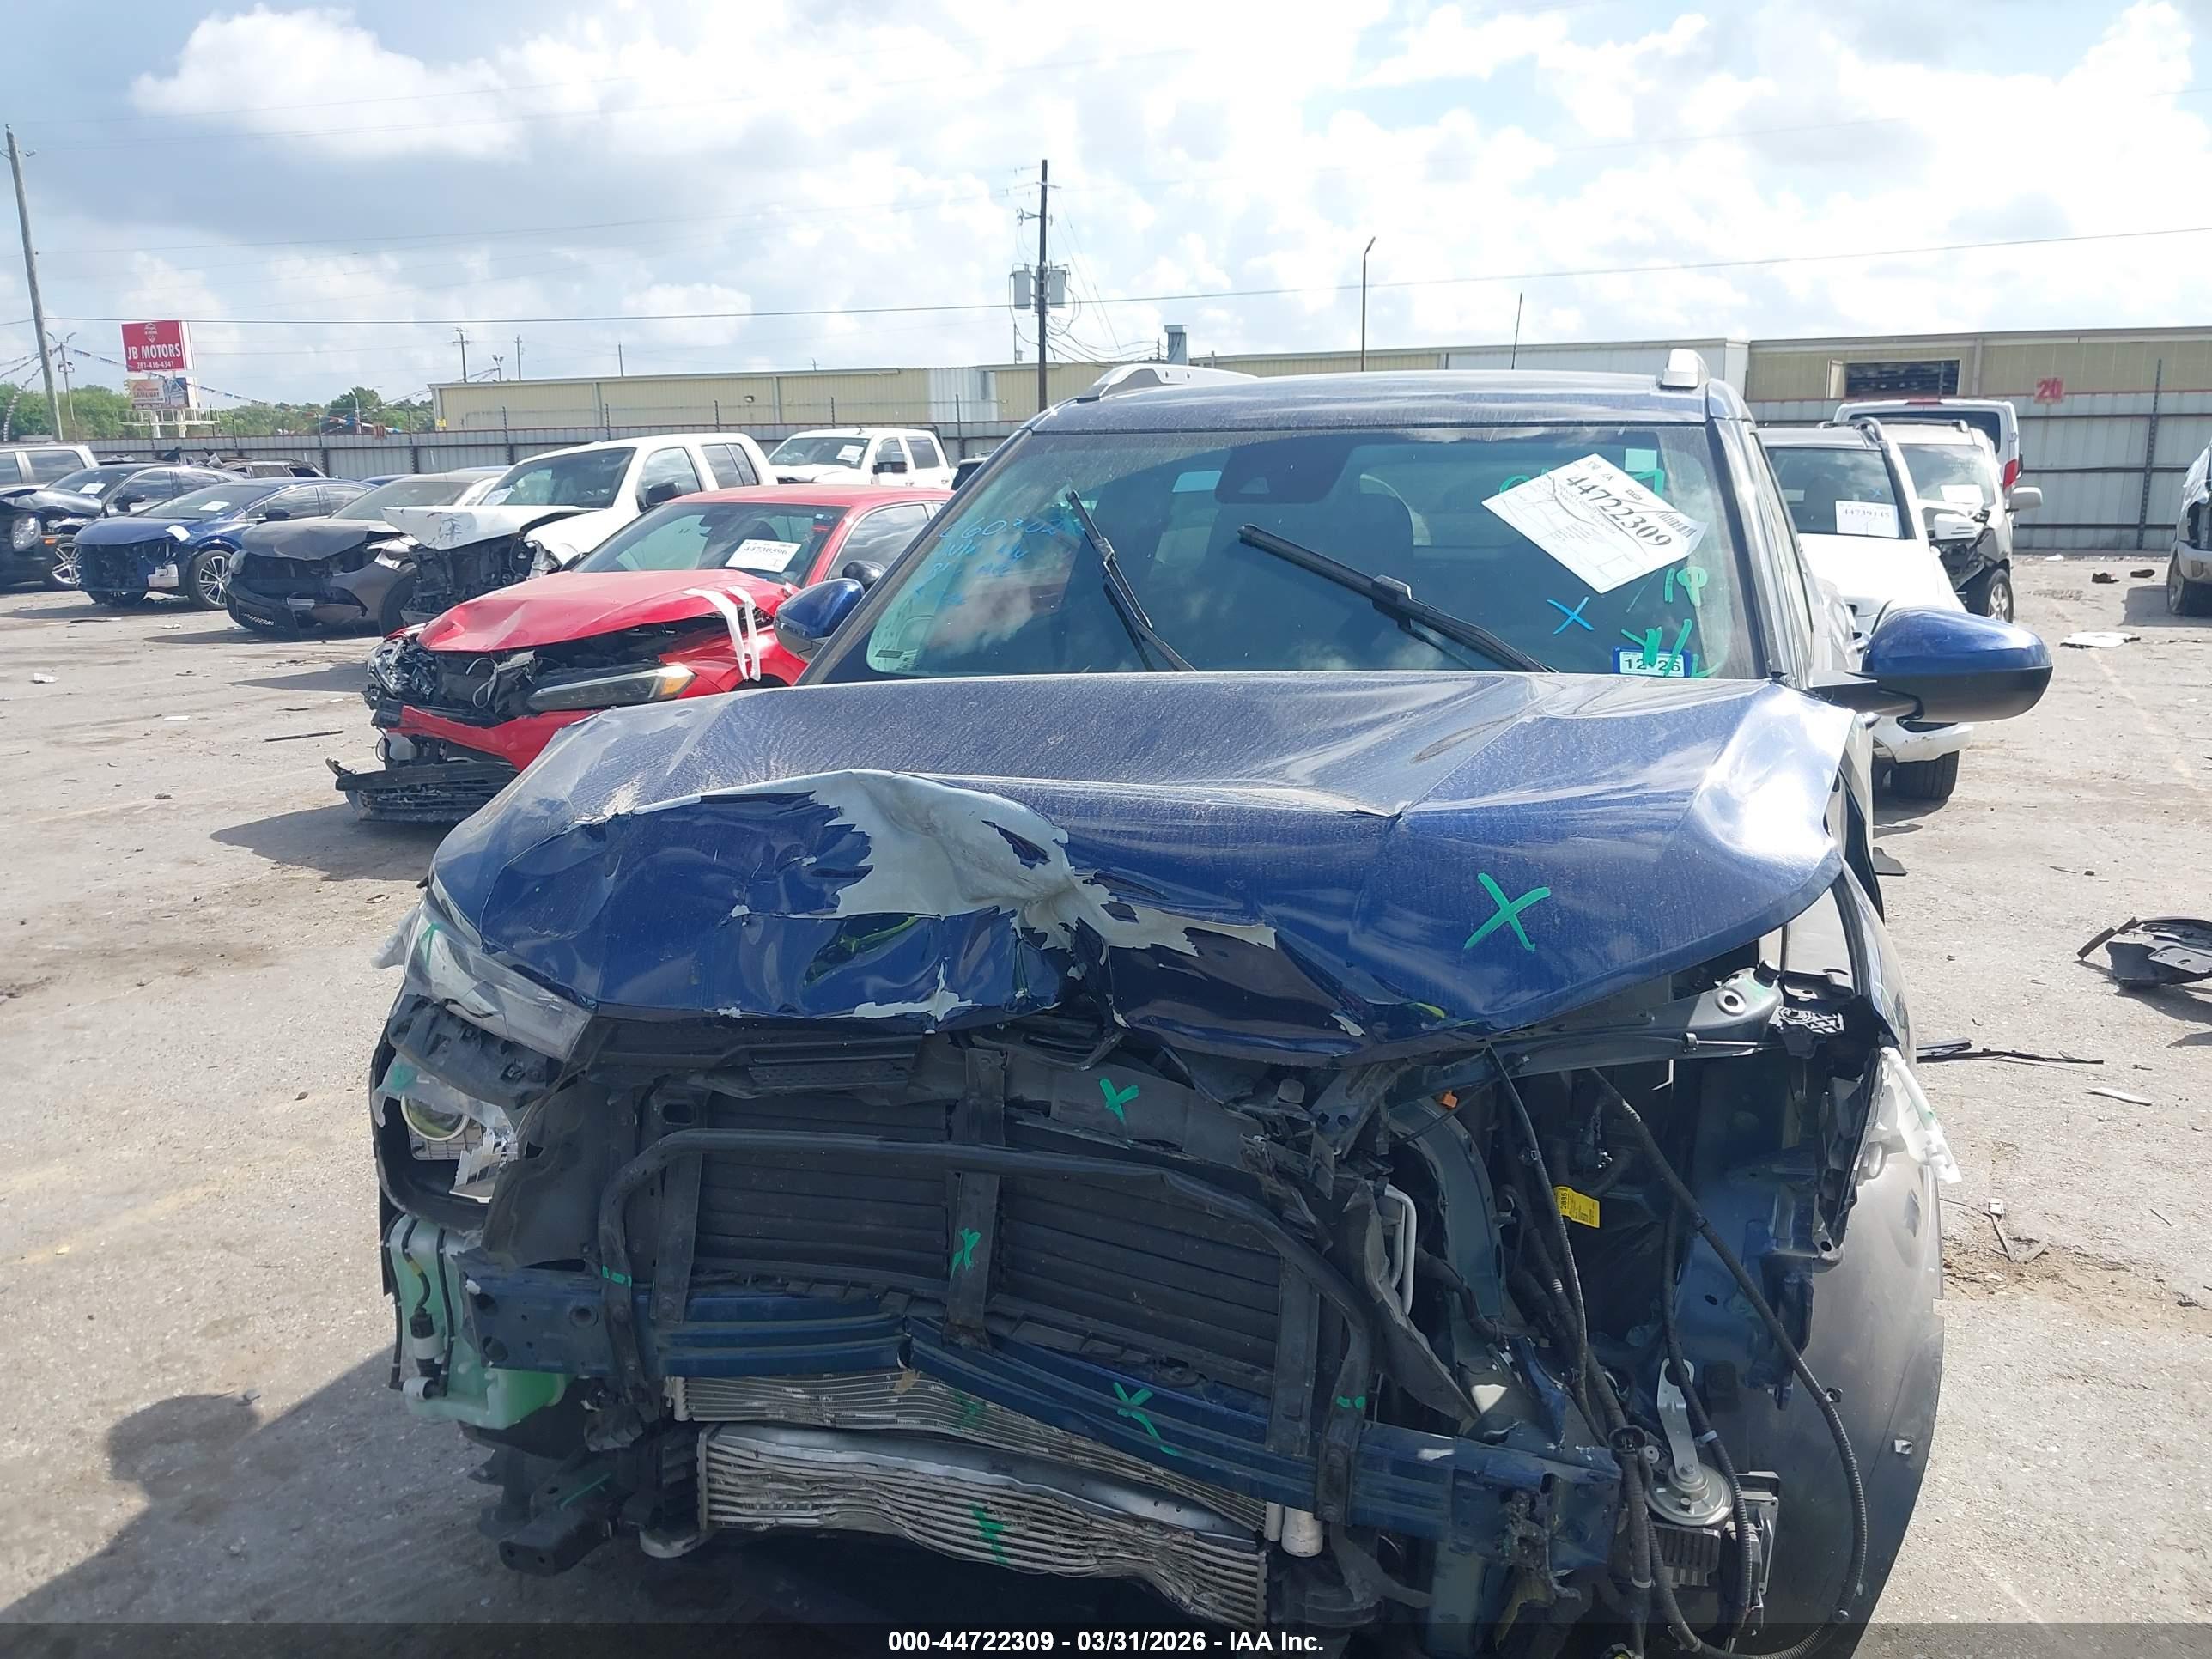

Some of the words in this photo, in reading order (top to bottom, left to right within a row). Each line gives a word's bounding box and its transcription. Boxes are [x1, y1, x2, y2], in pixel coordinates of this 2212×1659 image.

[127, 346, 138, 360] JB
[141, 343, 181, 359] MOTORS
[137, 360, 174, 369] 281-416-4341
[2036, 379, 2063, 401] 20
[1566, 477, 1672, 546] 44722309
[1624, 658, 1646, 670] 12
